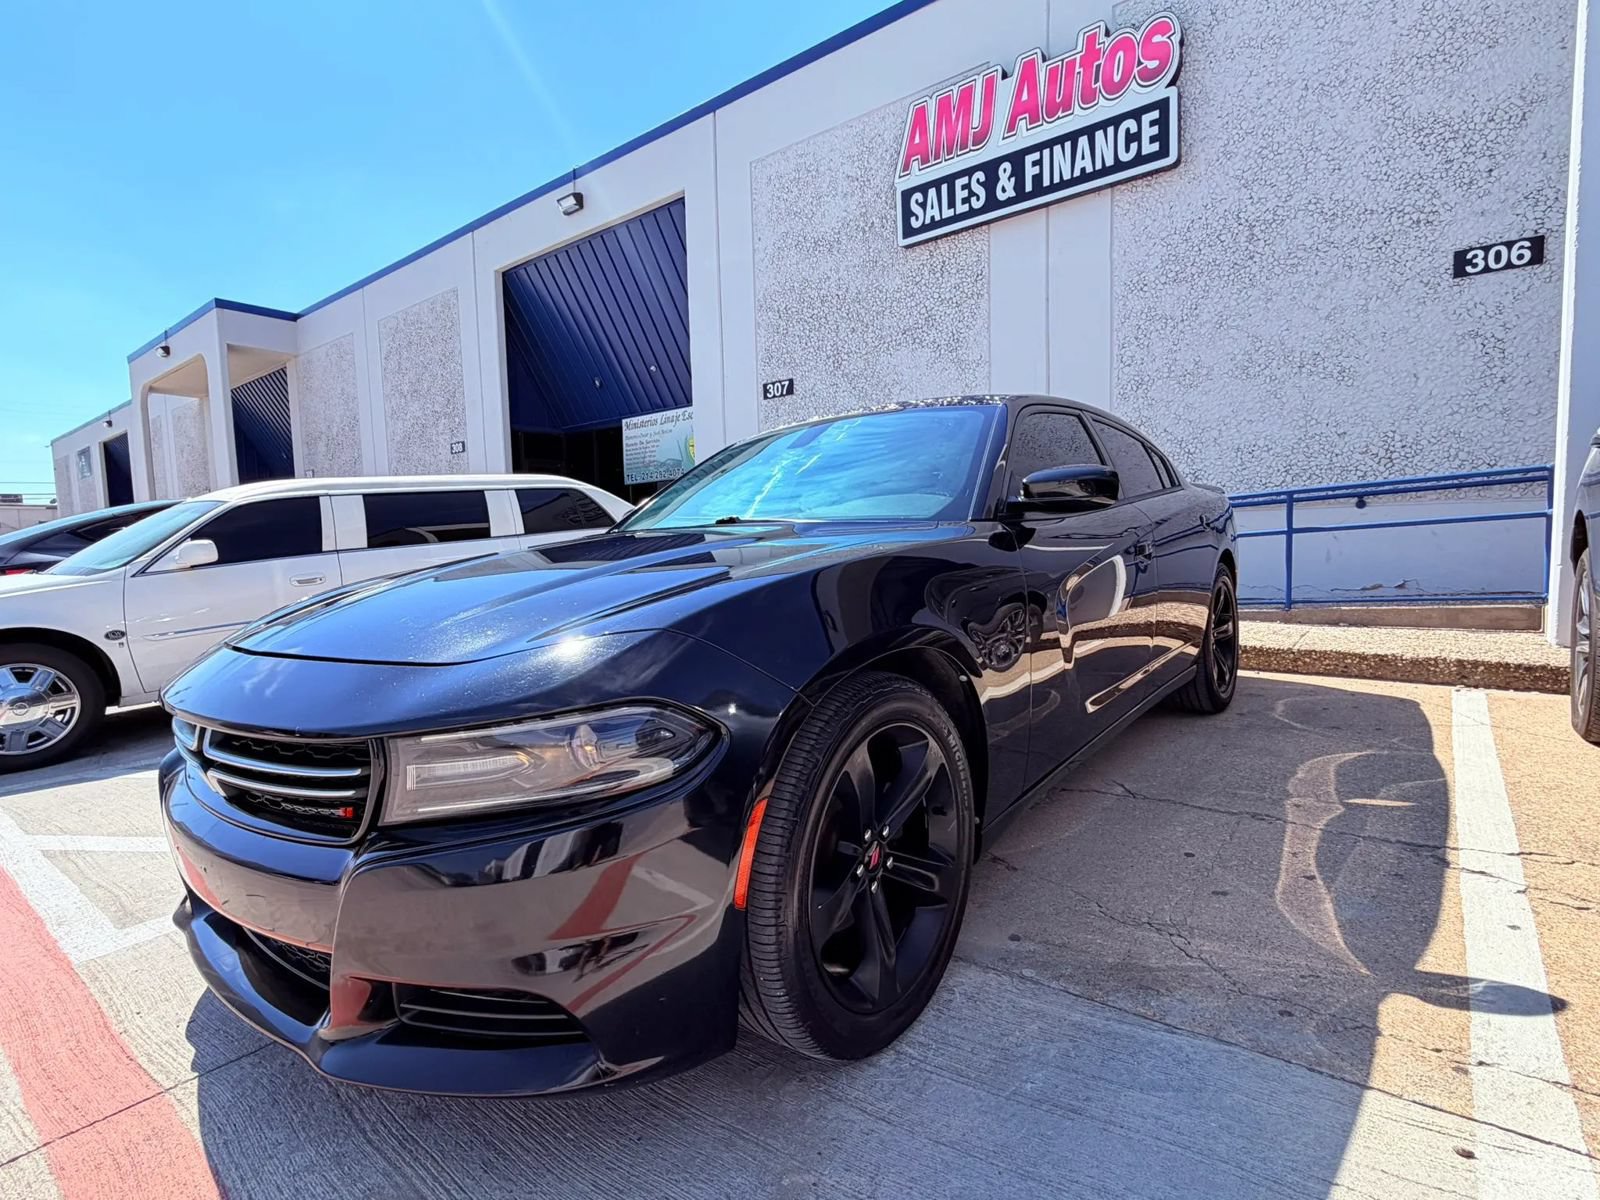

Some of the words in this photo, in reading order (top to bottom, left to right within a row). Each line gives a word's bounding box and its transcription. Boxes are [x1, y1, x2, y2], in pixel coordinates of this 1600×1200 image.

[900, 71, 998, 178] AMJ
[1002, 16, 1175, 139] Autos
[909, 171, 986, 229] SALES
[996, 161, 1016, 201] &
[1024, 110, 1160, 193] FINANCE
[1464, 241, 1532, 274] 306
[766, 381, 790, 398] 307
[624, 416, 658, 431] Ministerios
[659, 411, 681, 428] Linaje
